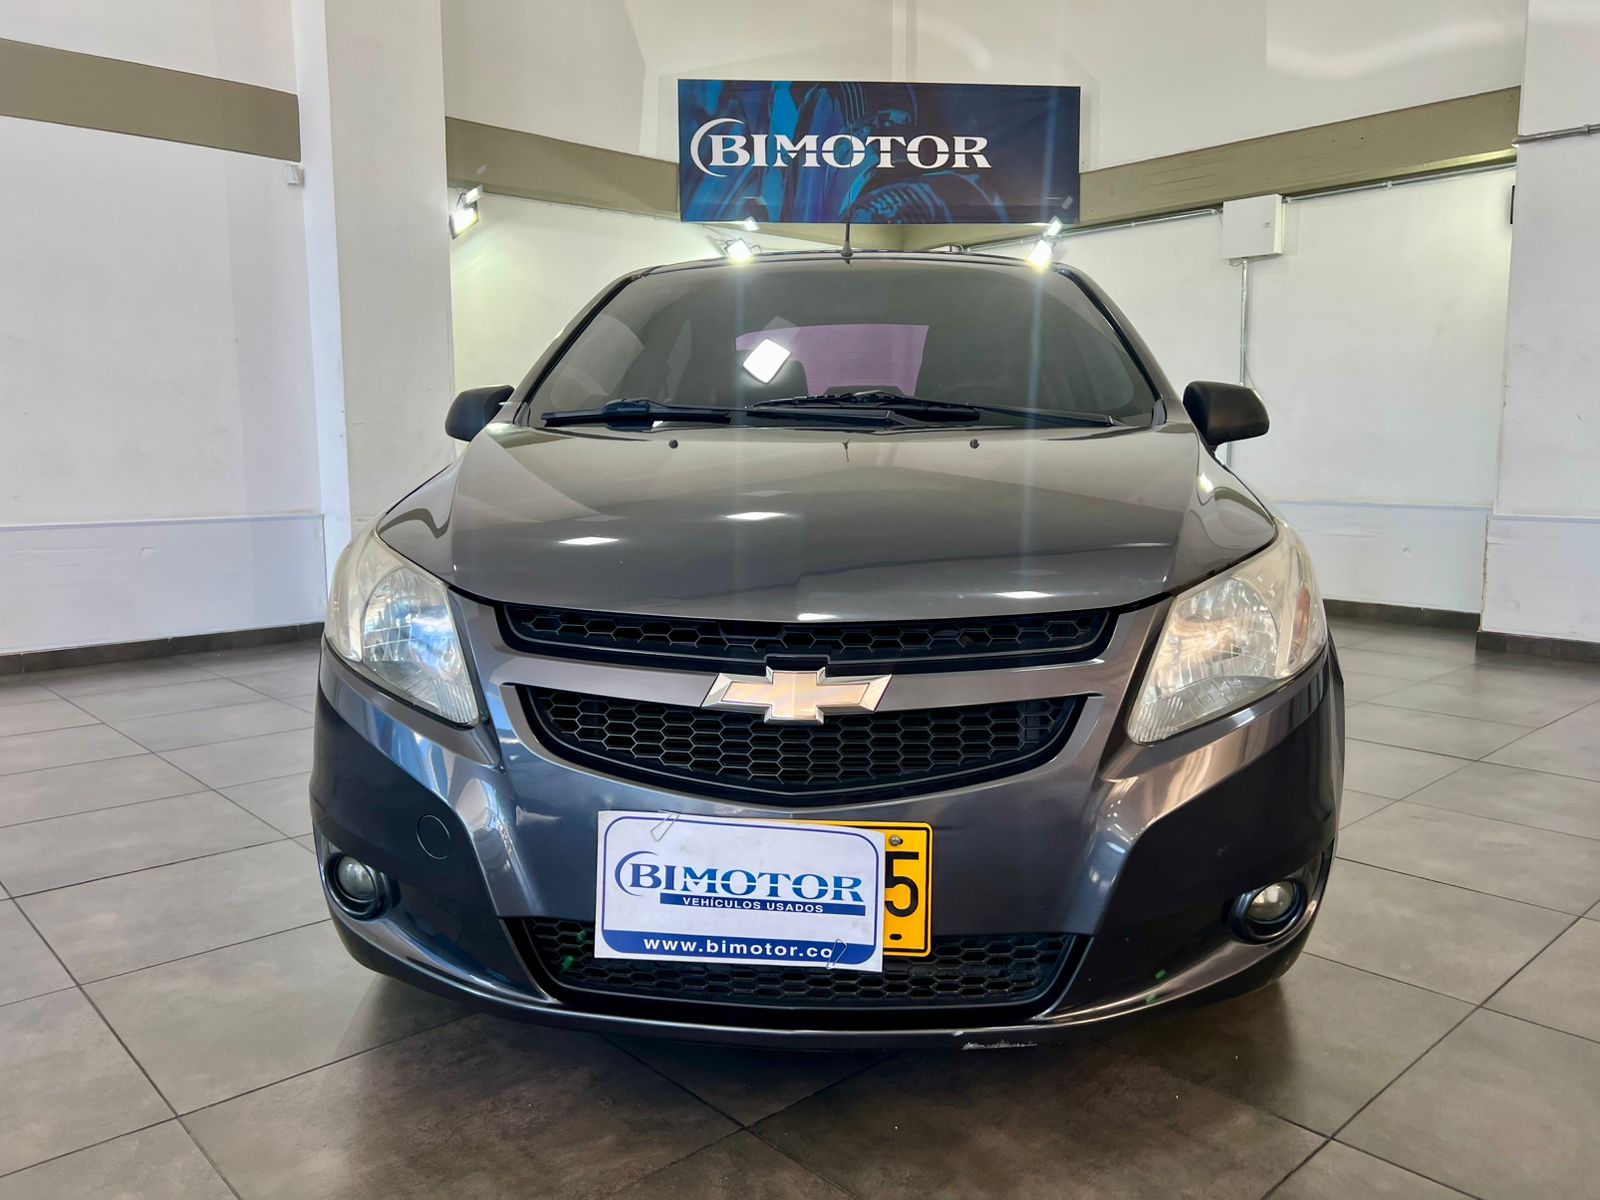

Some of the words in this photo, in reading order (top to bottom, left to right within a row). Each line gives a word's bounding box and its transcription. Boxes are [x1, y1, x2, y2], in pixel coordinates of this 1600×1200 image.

[708, 133, 992, 169] BIMOTOR
[629, 863, 864, 902] BIMOTOR
[885, 851, 919, 917] 5
[766, 902, 824, 913] USADOS
[643, 938, 833, 959] www.bimotor.co
